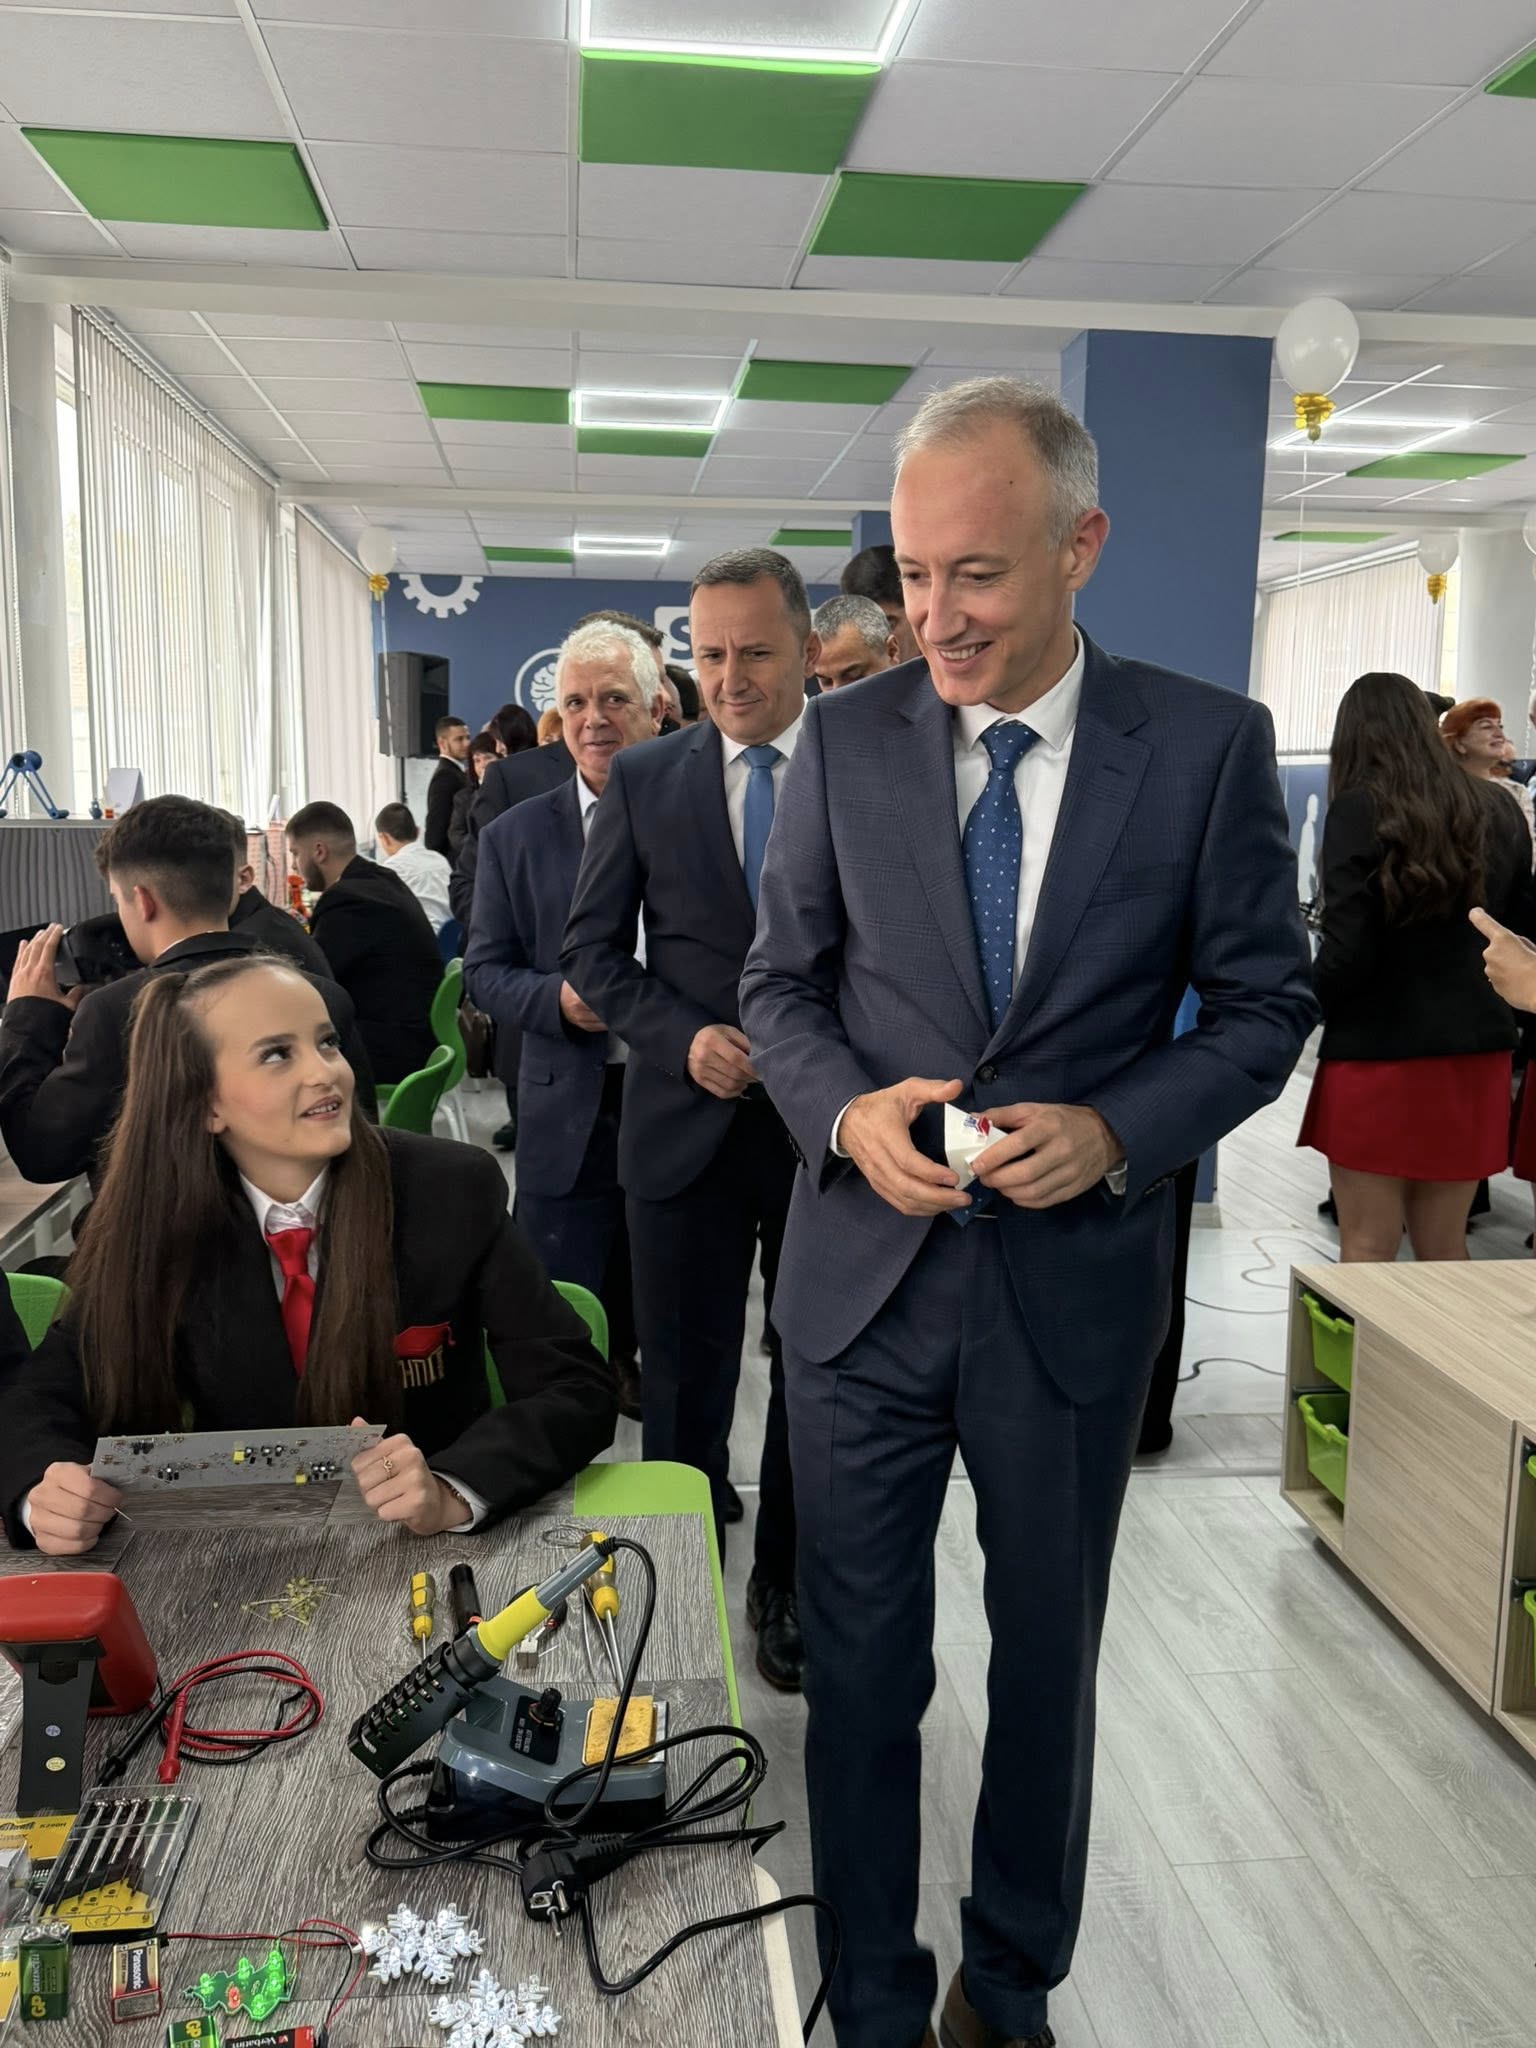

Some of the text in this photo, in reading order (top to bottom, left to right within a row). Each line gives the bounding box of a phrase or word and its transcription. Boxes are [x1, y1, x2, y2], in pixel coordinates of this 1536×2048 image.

[132, 1949, 144, 1990] Panasonic
[31, 1994, 46, 2018] GP
[185, 2020, 202, 2038] GP
